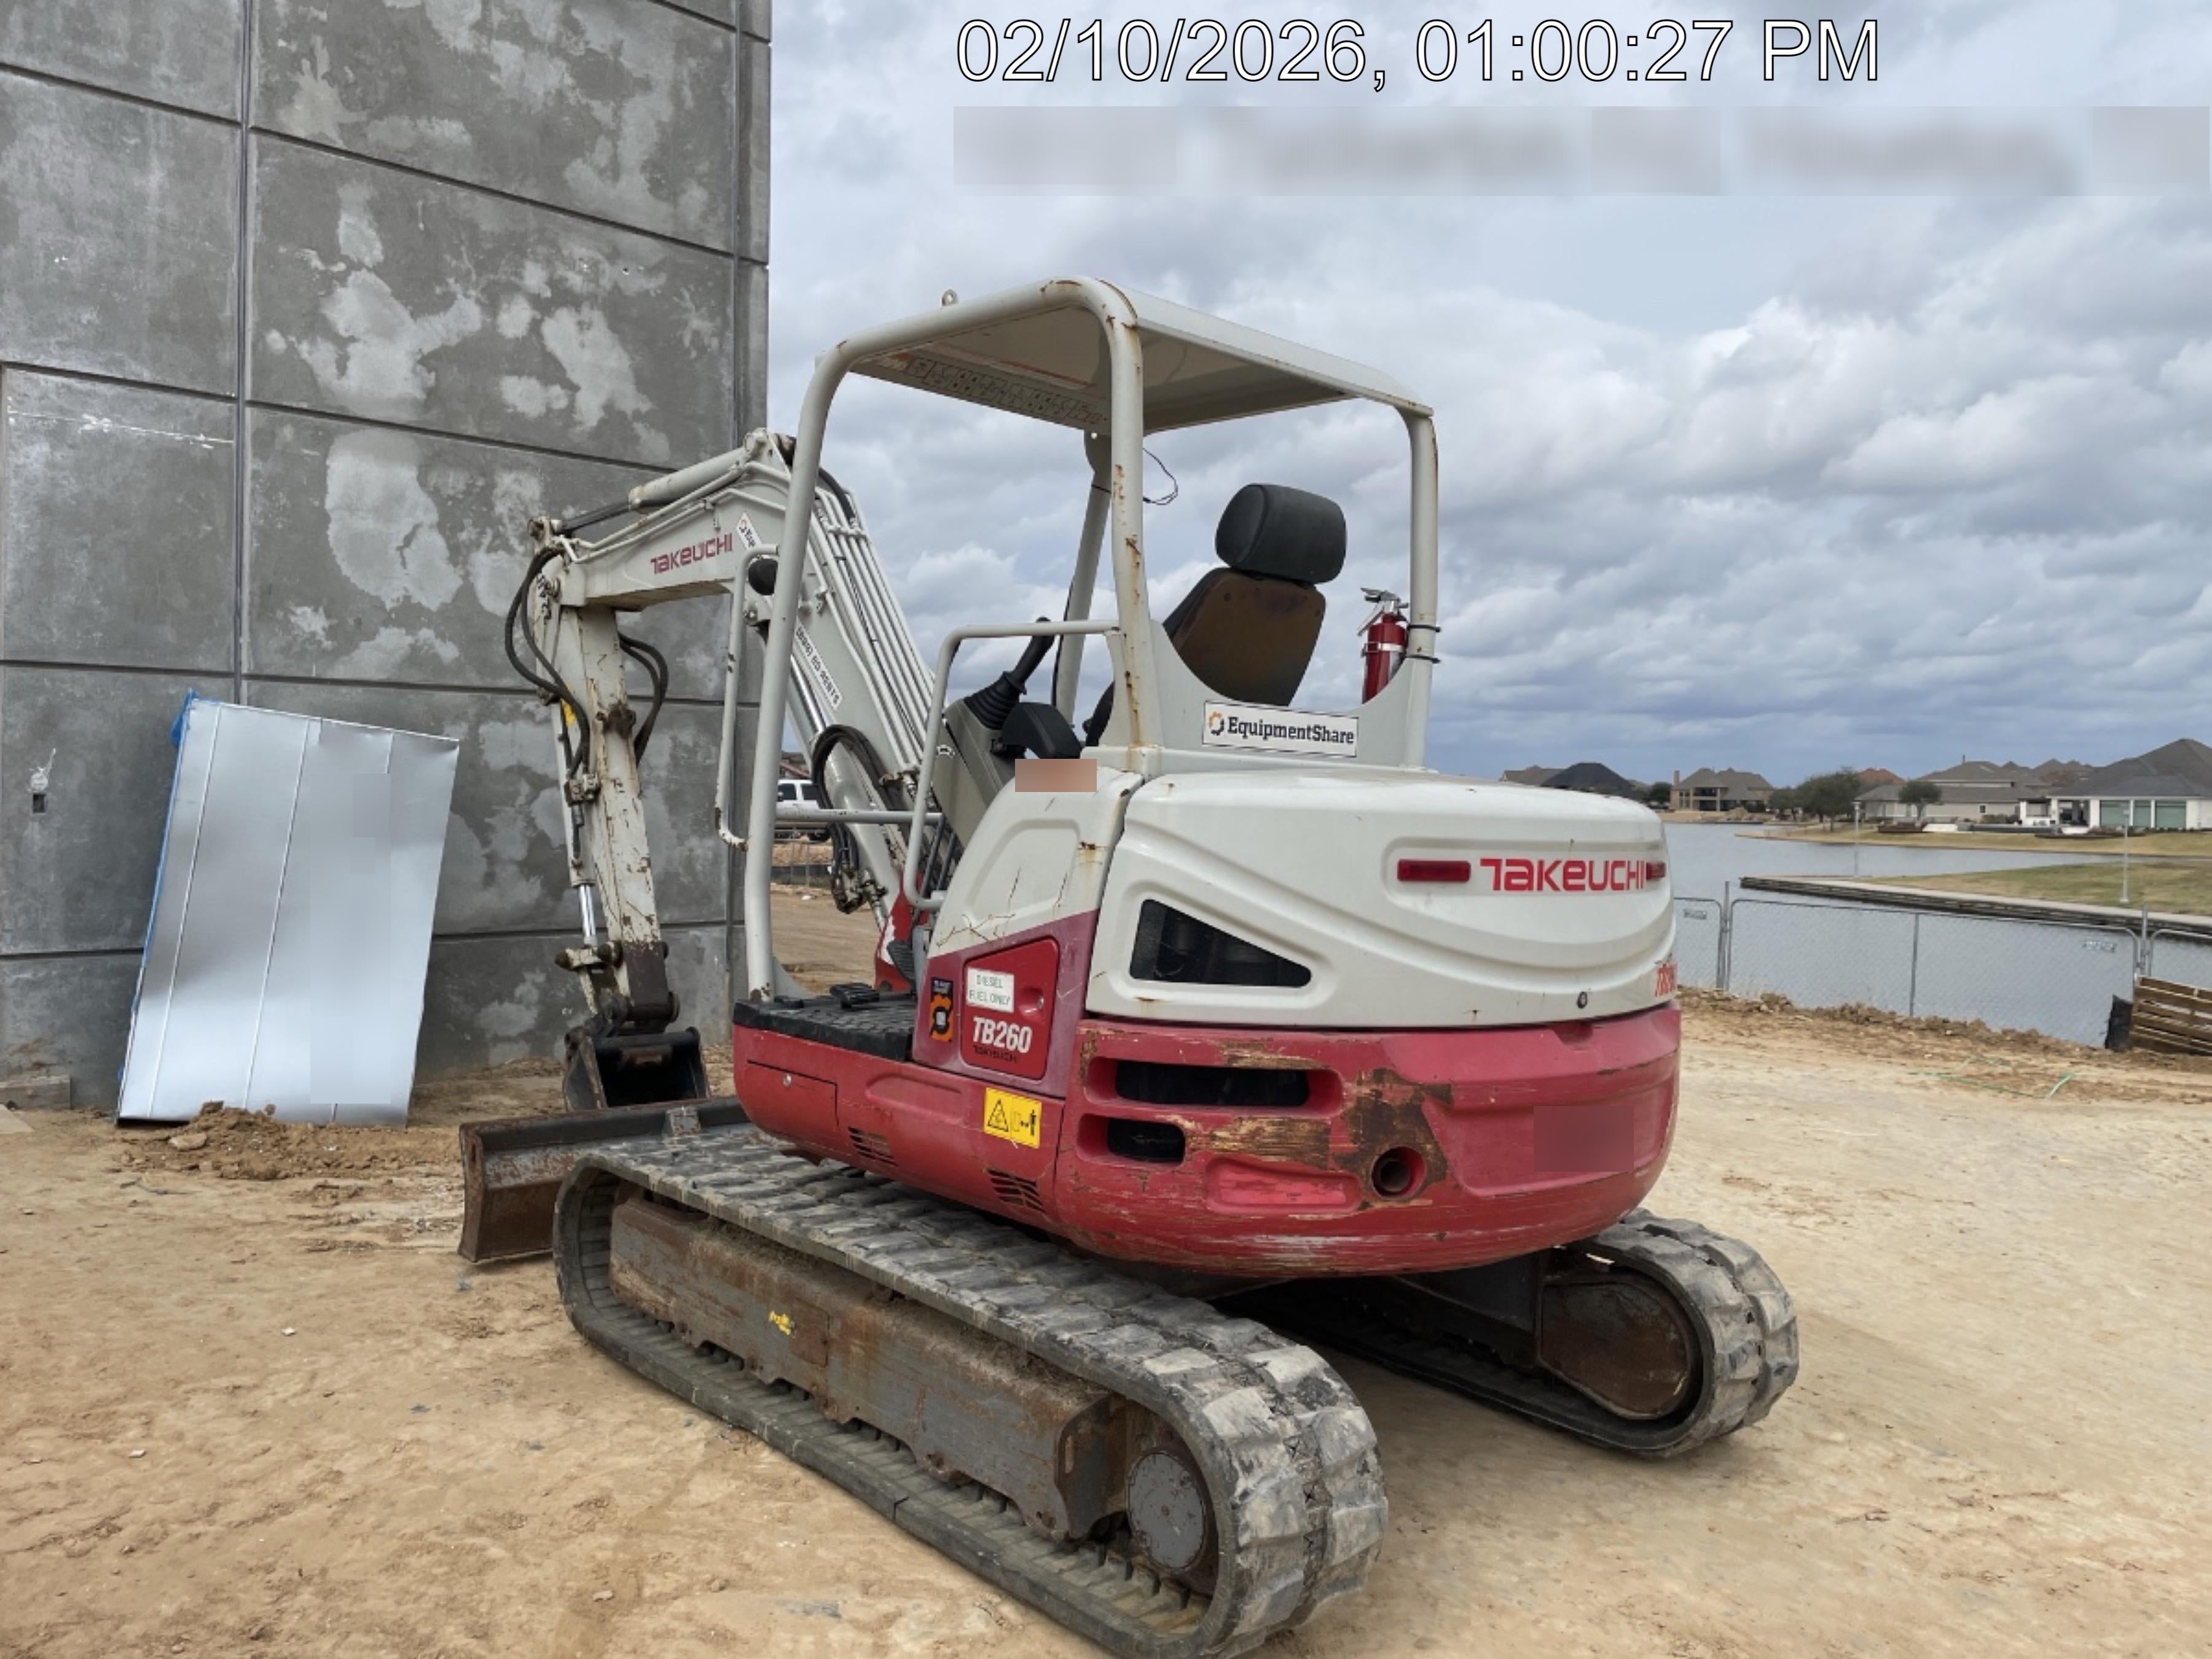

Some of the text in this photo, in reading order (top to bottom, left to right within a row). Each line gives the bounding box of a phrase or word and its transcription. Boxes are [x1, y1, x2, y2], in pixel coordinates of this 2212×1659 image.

[650, 532, 733, 576] TAKEUCHI
[1228, 716, 1354, 744] EquipmentShare
[1480, 858, 1645, 892] TAKEUCHI
[969, 989, 1011, 1006] FUEL ONLY
[976, 975, 1003, 989] DIESEL
[972, 1016, 1033, 1054] TB260
